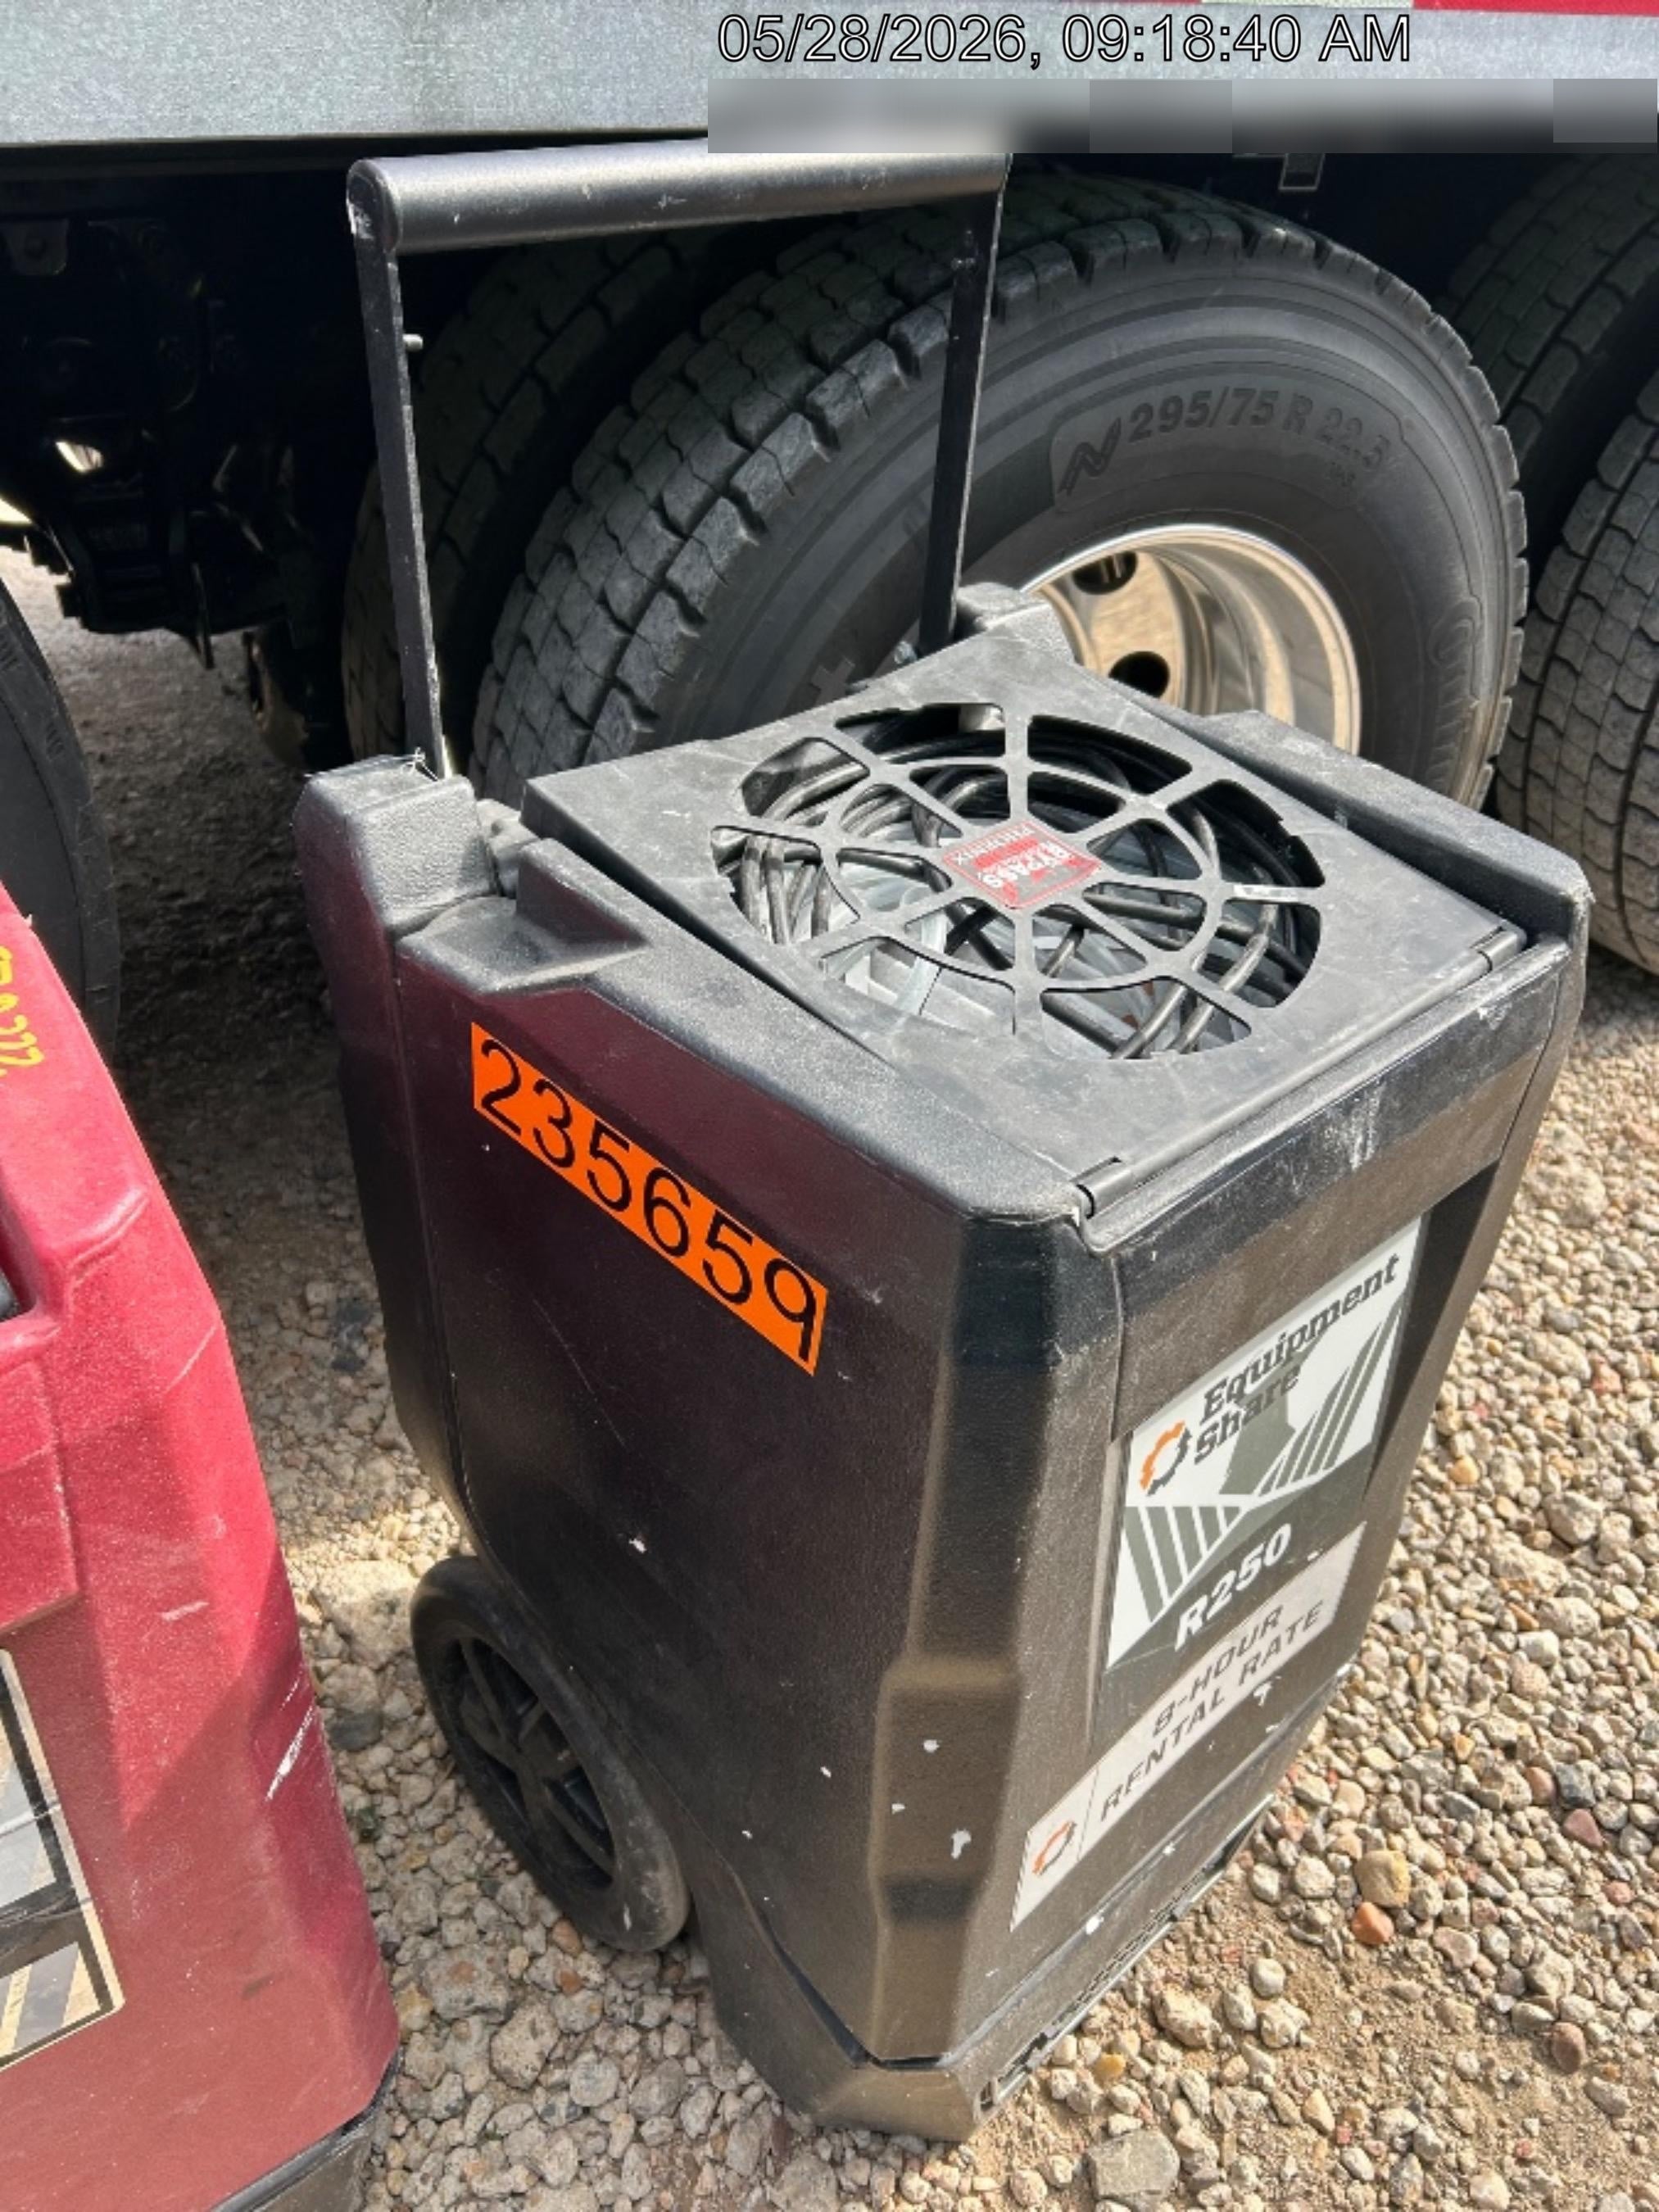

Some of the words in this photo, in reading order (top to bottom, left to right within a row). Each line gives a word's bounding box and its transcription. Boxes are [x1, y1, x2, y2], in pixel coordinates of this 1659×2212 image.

[1129, 386, 1280, 443] 295/75
[1281, 392, 1314, 436] R
[480, 1038, 818, 1362] 235659
[1199, 1253, 1400, 1426] Equipment
[1194, 1363, 1302, 1466] Share
[1174, 1523, 1292, 1652] R250
[1100, 1687, 1226, 1822] RENTAL
[1238, 1599, 1325, 1686] RATE
[1152, 1604, 1284, 1737] 8-HOUR
